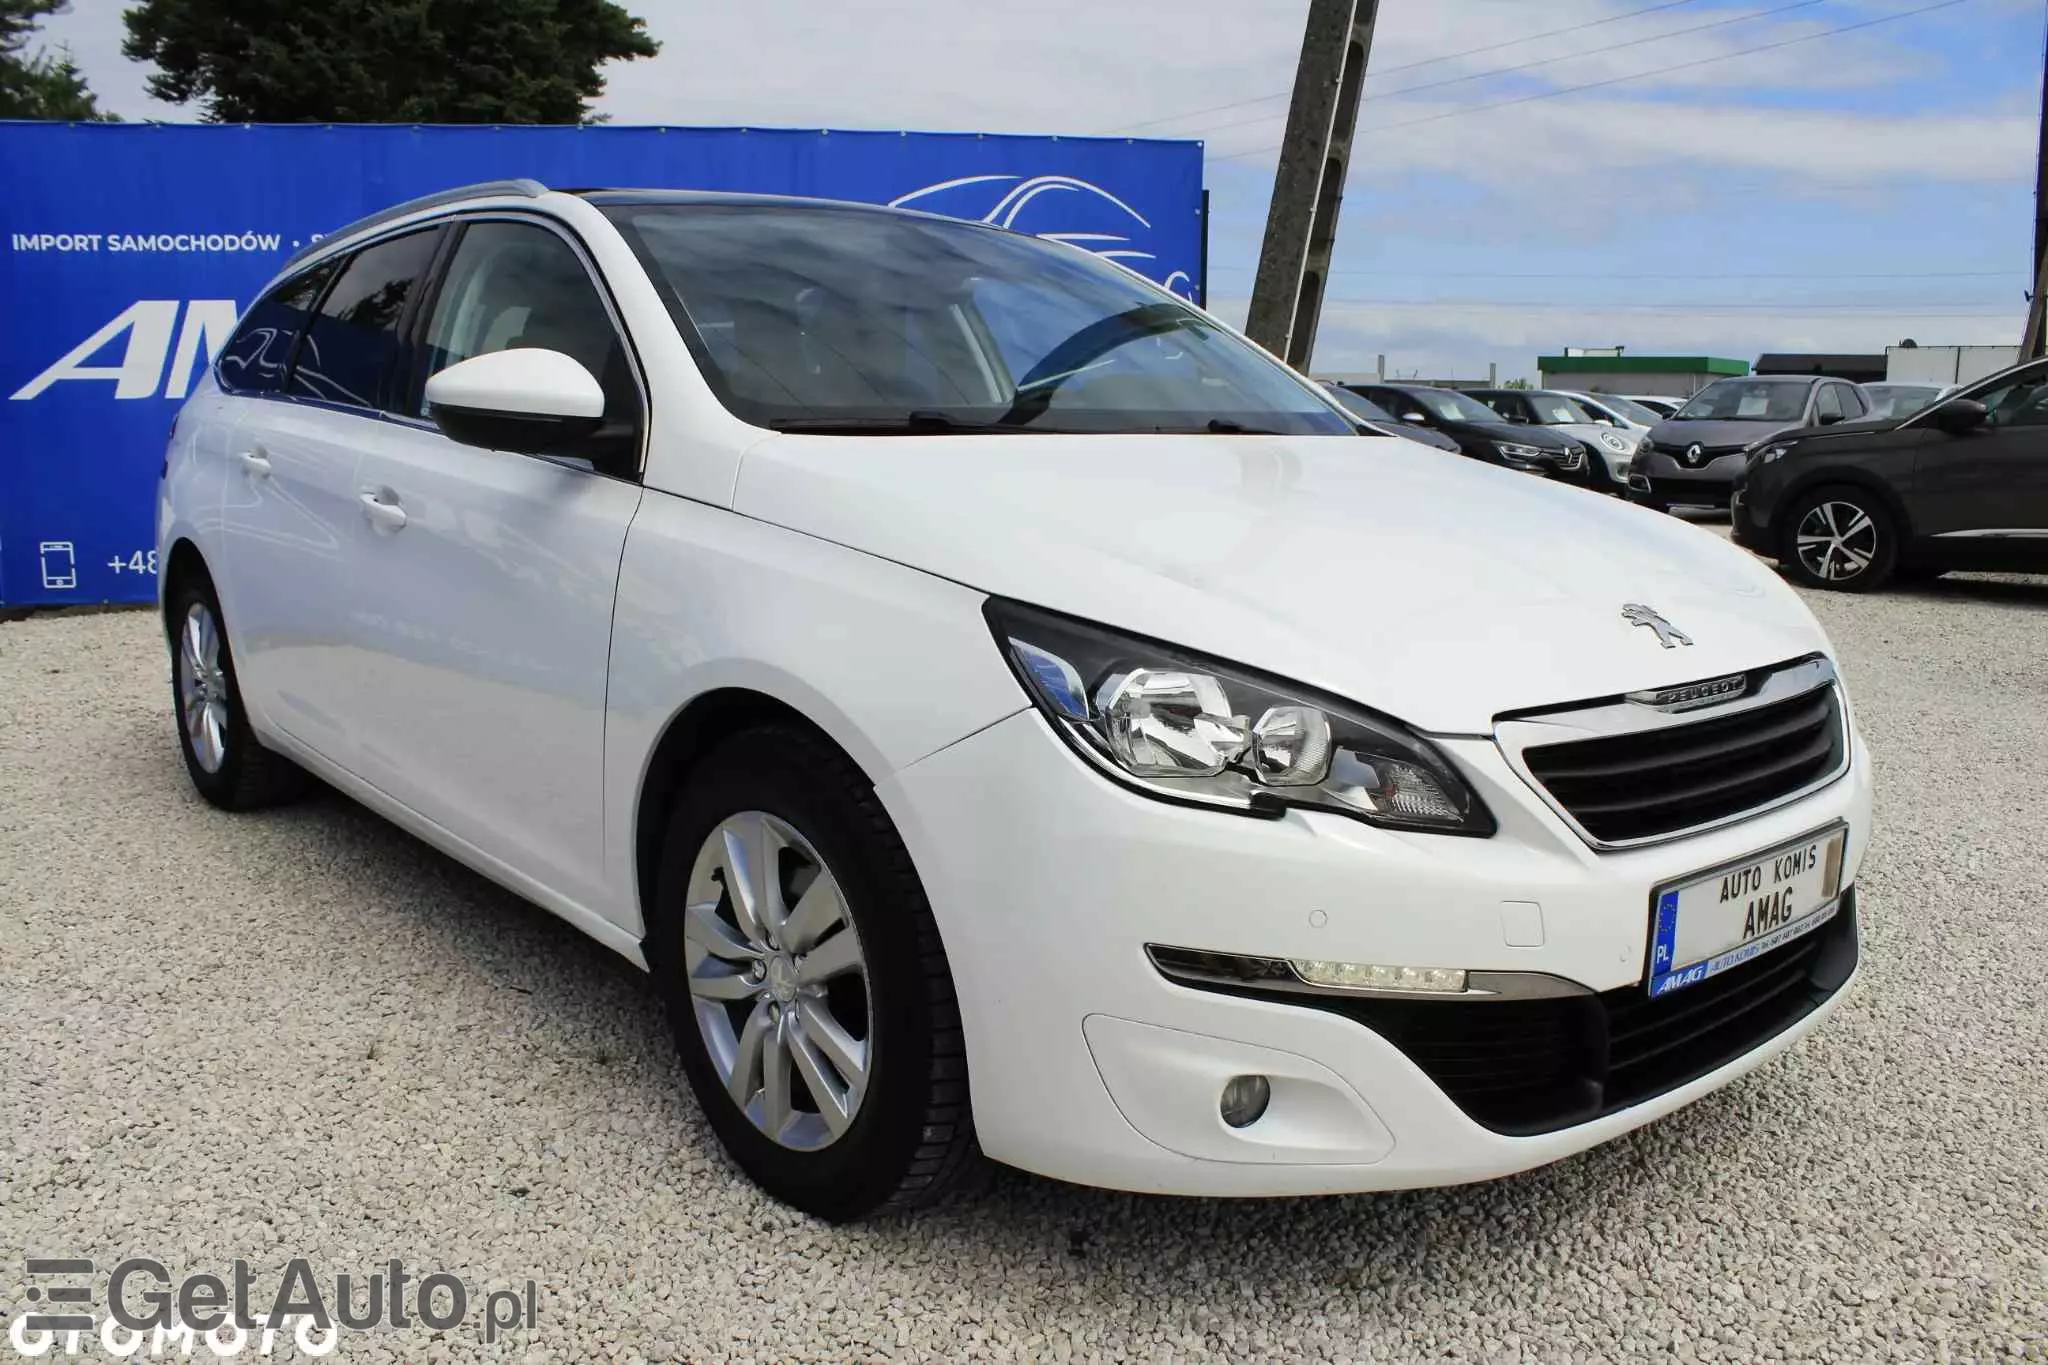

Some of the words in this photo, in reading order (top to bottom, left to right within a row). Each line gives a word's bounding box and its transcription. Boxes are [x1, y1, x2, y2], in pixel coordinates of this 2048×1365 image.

[12, 233, 102, 251] IMPORT
[107, 230, 281, 252] SAMOCHODÓW
[1665, 679, 1739, 704] PEUGEOT
[1719, 866, 1762, 904] AUTO
[1773, 844, 1817, 884] KOMIS
[1742, 886, 1793, 940] AMAG
[1656, 944, 1670, 964] PL
[1657, 964, 1704, 995] AMAG
